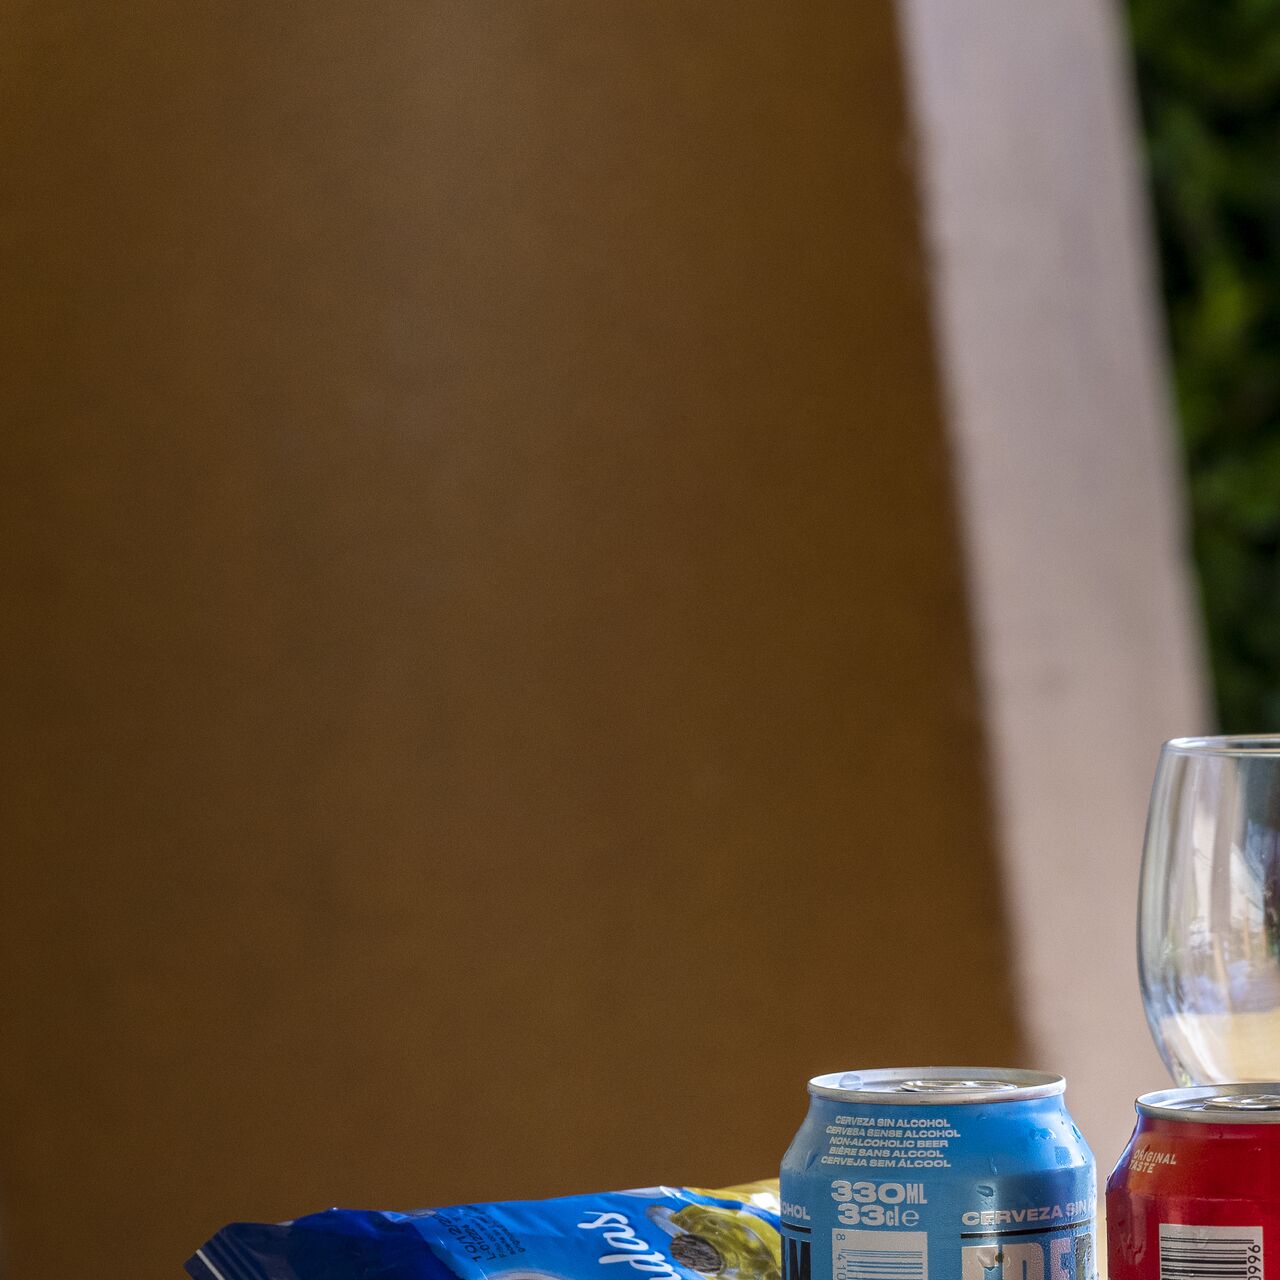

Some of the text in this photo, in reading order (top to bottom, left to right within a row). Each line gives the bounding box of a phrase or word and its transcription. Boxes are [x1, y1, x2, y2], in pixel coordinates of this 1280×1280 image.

[835, 1115, 951, 1128] CERVEZA SIN ALCOHOL
[904, 1129, 961, 1138] ALCOHOL
[829, 1136, 949, 1148] NON-ALCOHOLIC BEER
[858, 1148, 890, 1158] SANS
[892, 1150, 944, 1158] ALCOOL
[1133, 1149, 1177, 1165] ORIGINAL
[821, 1156, 868, 1167] CERVEJA
[868, 1159, 896, 1168] SEM
[1128, 1159, 1156, 1174] TASTE
[830, 1180, 928, 1204] 330ML
[962, 1204, 1064, 1226] CERVEZA
